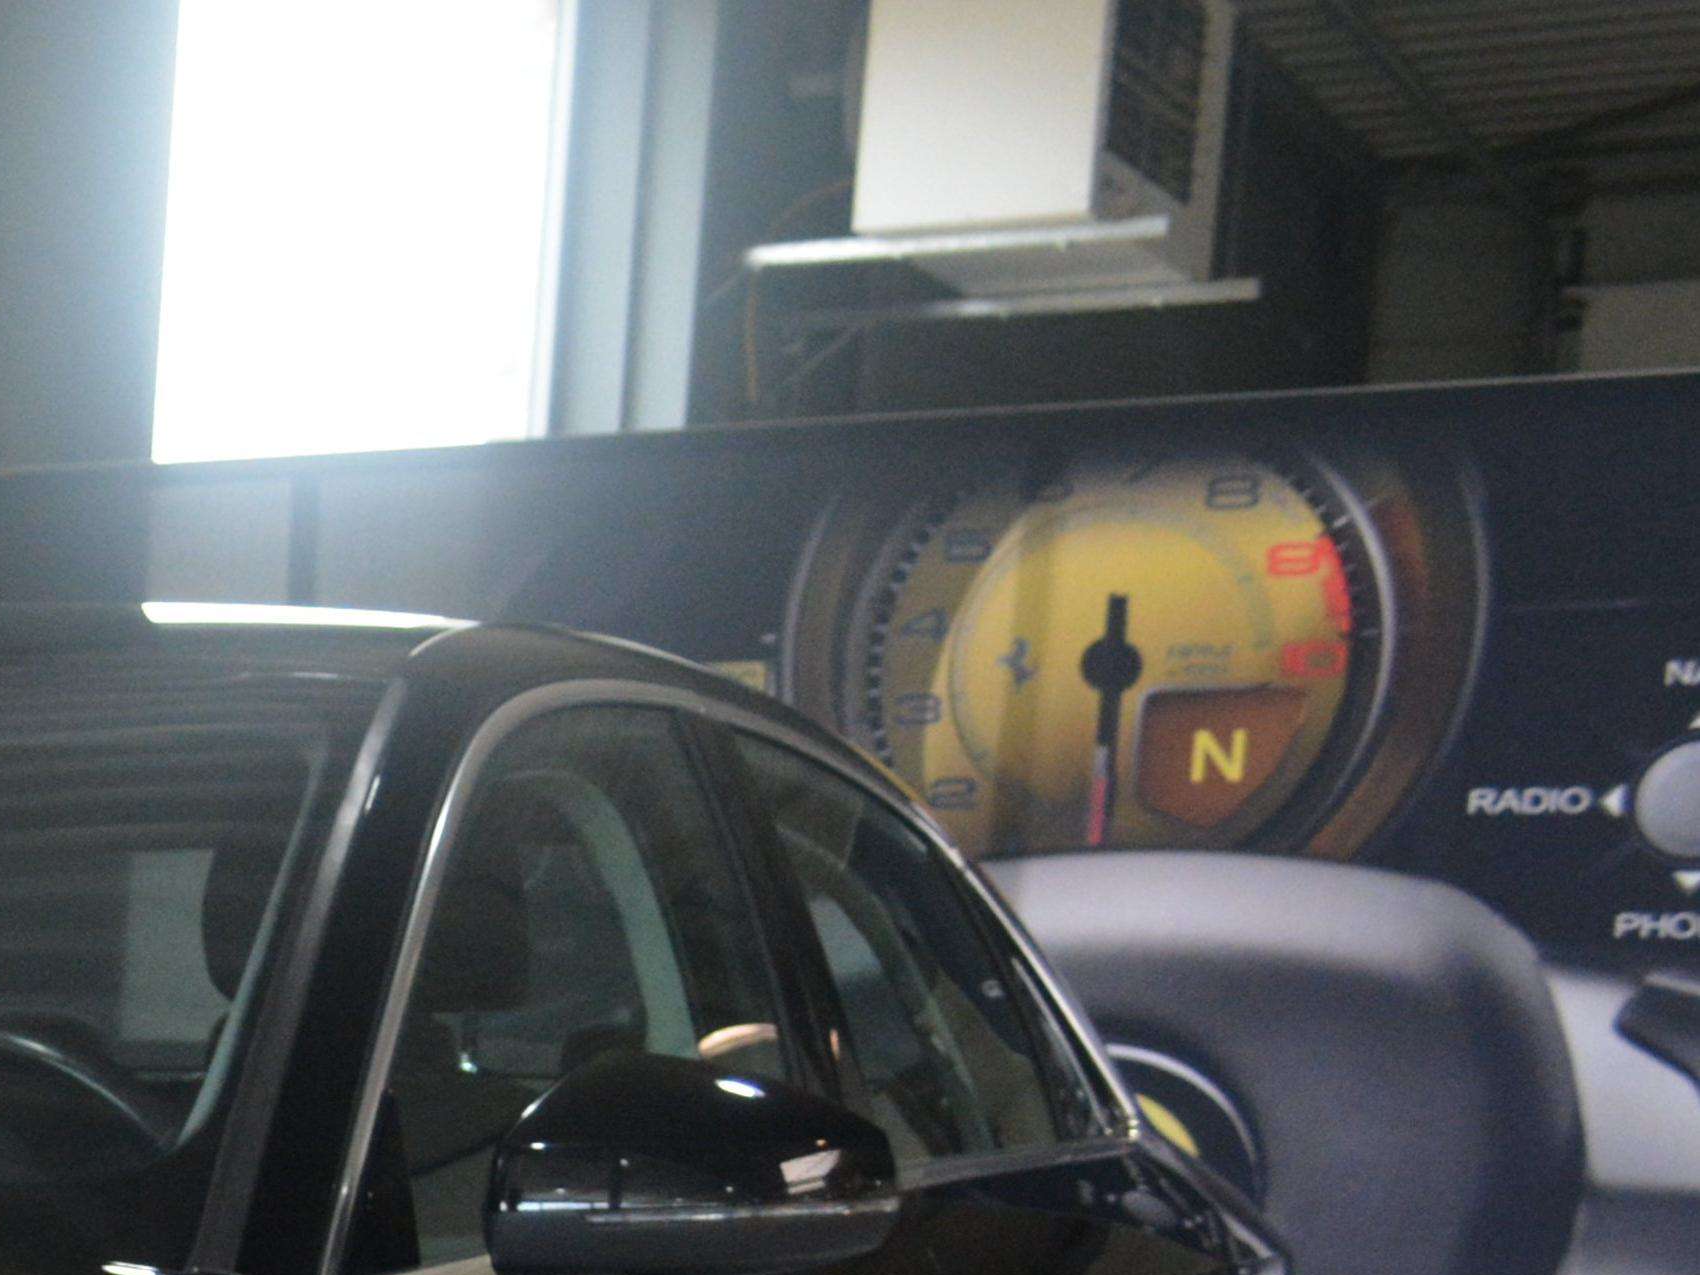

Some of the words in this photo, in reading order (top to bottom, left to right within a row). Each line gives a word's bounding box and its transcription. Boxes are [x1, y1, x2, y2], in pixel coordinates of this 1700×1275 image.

[1206, 475, 1259, 511] 8
[1188, 728, 1249, 784] N
[1466, 786, 1593, 816] RADIO
[1612, 911, 1700, 940] PHO
